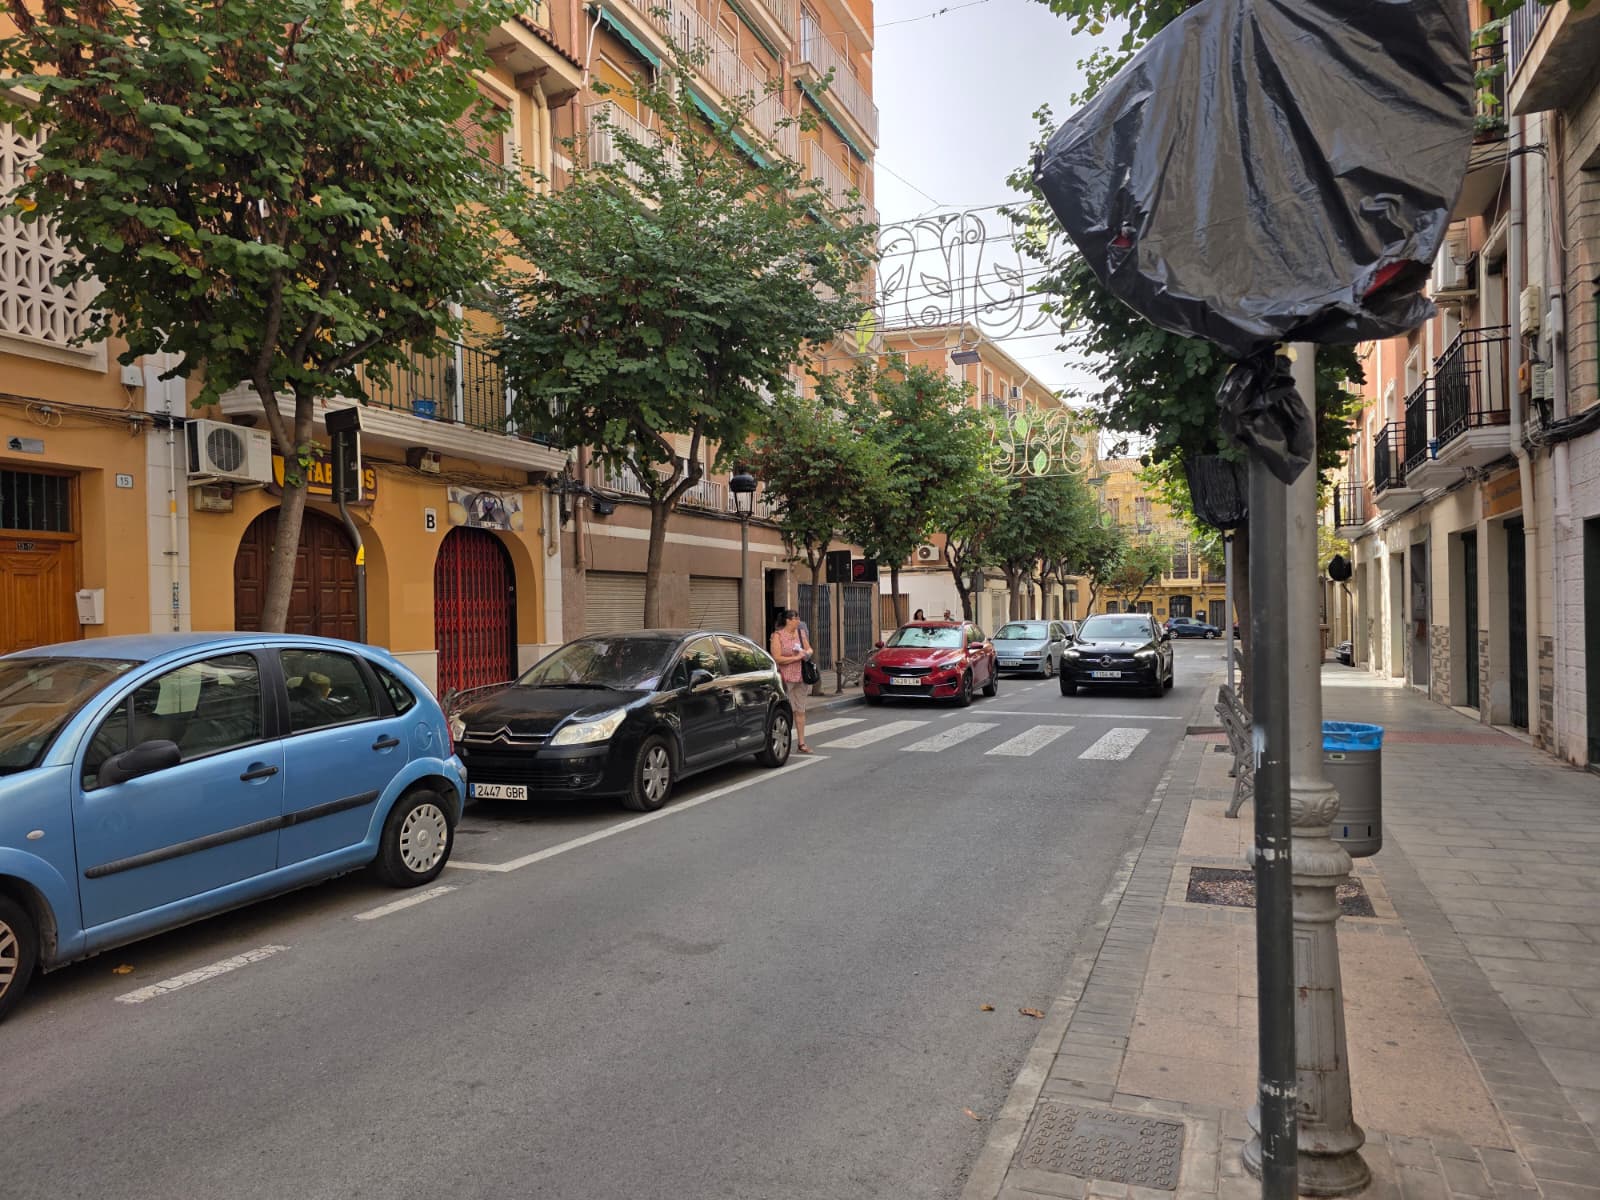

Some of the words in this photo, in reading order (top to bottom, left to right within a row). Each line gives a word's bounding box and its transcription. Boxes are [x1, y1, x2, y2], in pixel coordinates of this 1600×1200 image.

[426, 514, 436, 529] B
[477, 785, 501, 797] 2447
[505, 786, 525, 799] GBR
